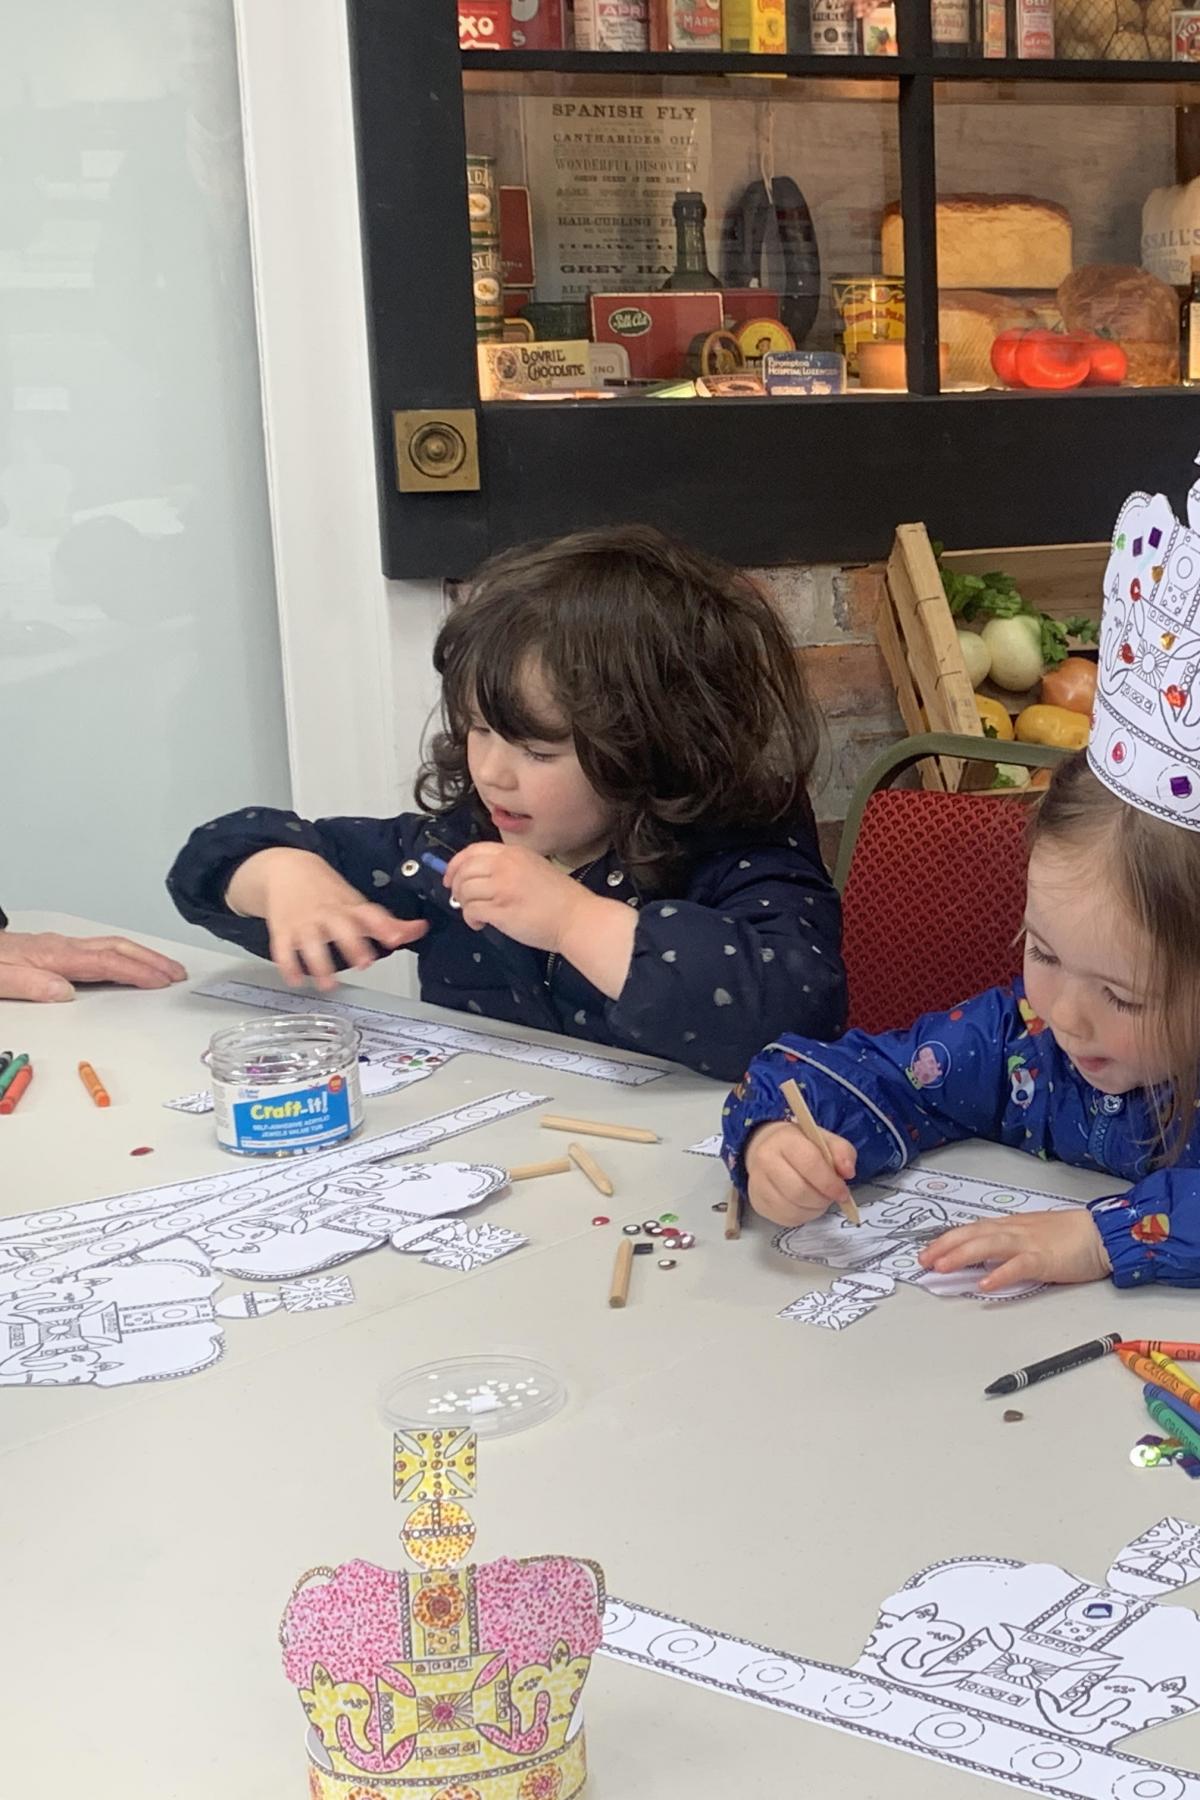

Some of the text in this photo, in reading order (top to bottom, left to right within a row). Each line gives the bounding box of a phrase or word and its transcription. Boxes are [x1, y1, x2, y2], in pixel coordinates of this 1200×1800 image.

[552, 103, 696, 120] SPANISH FLY
[555, 158, 632, 173] WONDERFUL
[560, 264, 674, 275] GREY HA
[520, 348, 566, 364] BOVRIL
